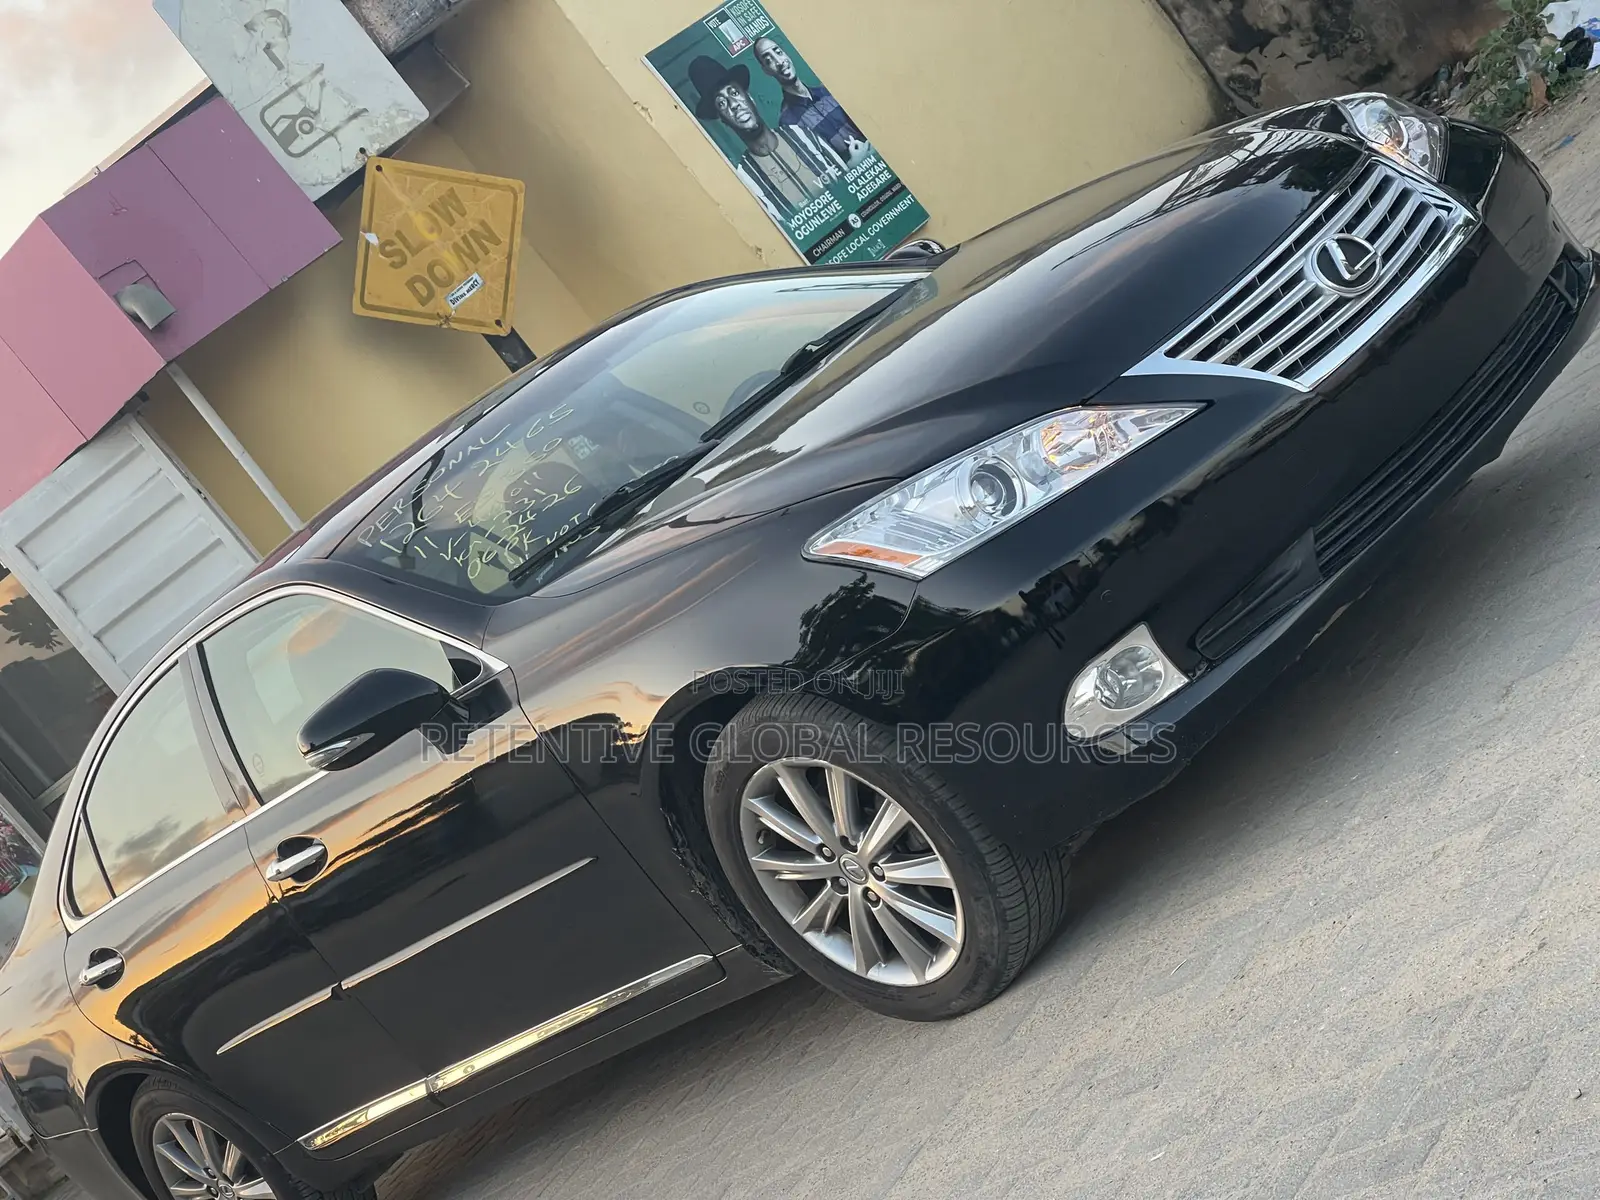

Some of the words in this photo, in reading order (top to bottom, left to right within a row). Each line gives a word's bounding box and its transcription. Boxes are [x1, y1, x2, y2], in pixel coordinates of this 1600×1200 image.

[707, 17, 721, 29] VOTE
[729, 0, 754, 18] KOSOFE
[736, 16, 747, 27] IN
[743, 6, 761, 21] SAFE
[744, 15, 770, 38] HANDS
[732, 40, 746, 52] APC
[812, 164, 842, 189] VOTE
[844, 154, 877, 183] IBRAHIM
[847, 160, 887, 194] OLALEKAN
[856, 169, 892, 202] ADEBARE
[788, 190, 834, 231] MOYOSORE
[794, 199, 843, 240] OGUNLEWE
[845, 232, 870, 254] LOCAL
[867, 193, 915, 236] GOVERNMENT
[851, 216, 859, 225] AS
[378, 186, 467, 270] SLOW
[812, 228, 846, 257] CHAIRMAN
[404, 218, 502, 307] DOWN
[357, 423, 511, 547] PERSONAL
